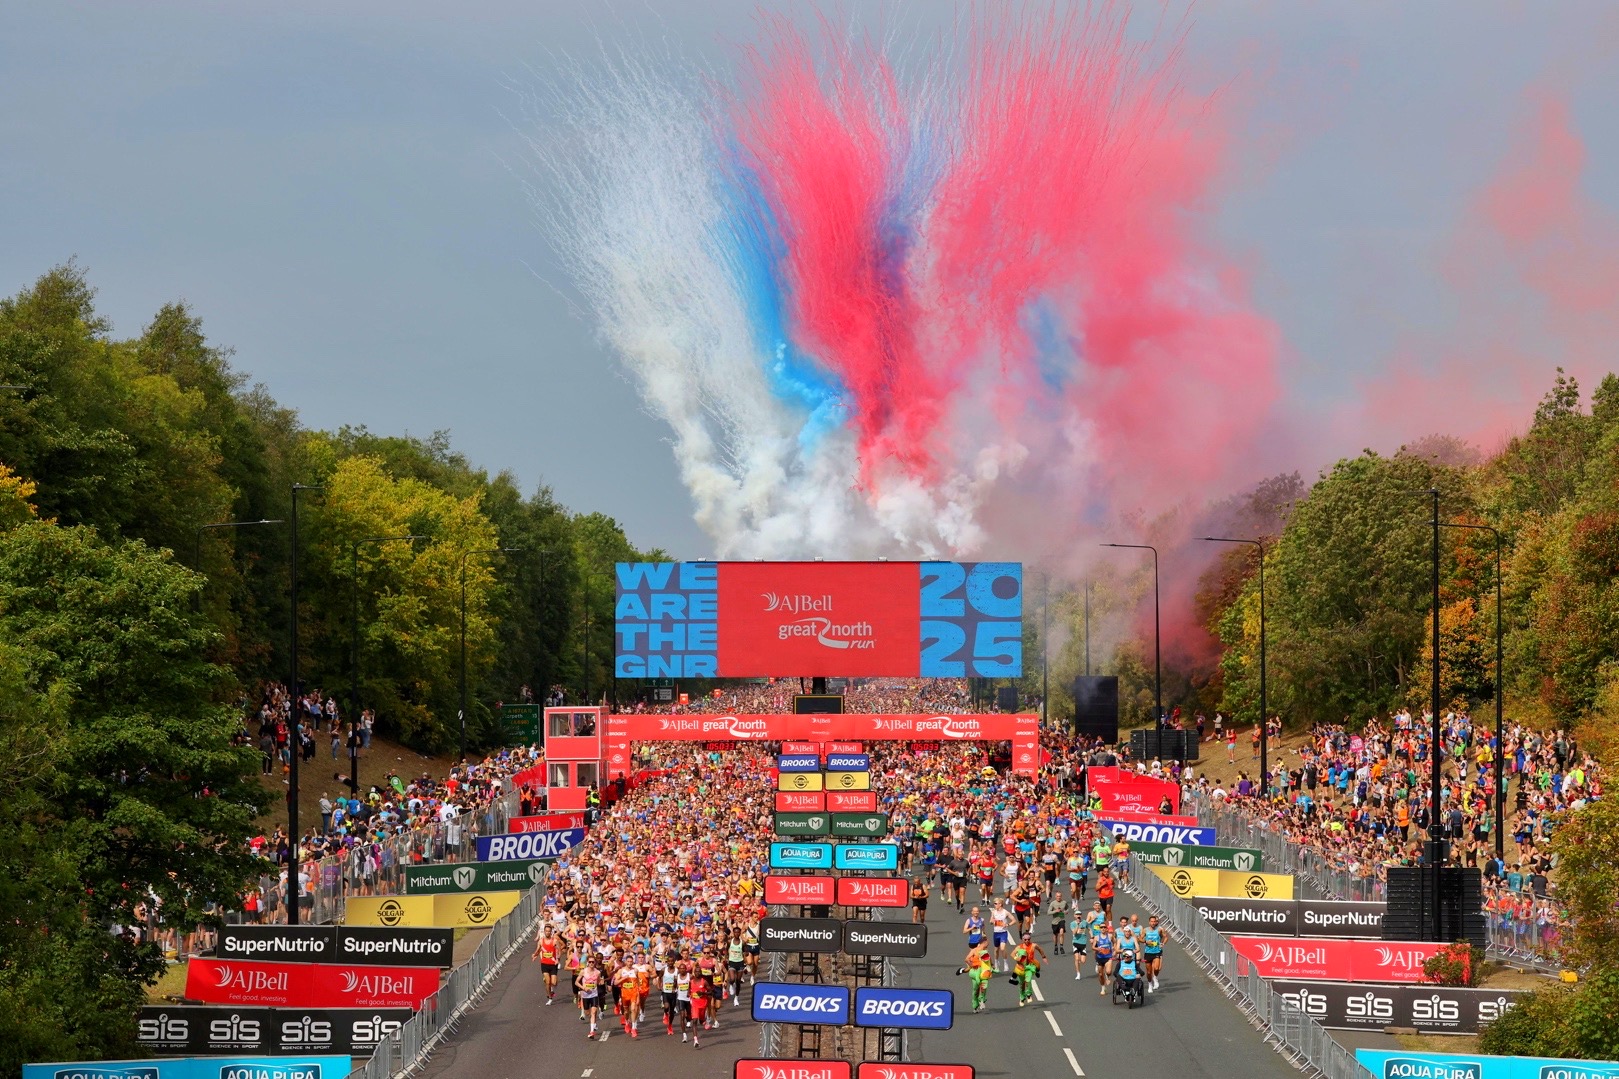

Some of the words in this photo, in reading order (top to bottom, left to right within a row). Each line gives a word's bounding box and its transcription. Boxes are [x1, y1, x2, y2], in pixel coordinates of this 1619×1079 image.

[615, 562, 717, 589] WE
[920, 562, 1022, 617] 20
[615, 593, 717, 619] ARE
[615, 623, 717, 650] THE
[779, 622, 817, 640] great
[832, 621, 872, 636] north
[850, 640, 875, 649] run
[920, 620, 1022, 677] 25
[615, 654, 717, 678] GNR
[703, 720, 728, 731] great
[739, 719, 766, 730] north
[916, 720, 942, 731] great
[952, 719, 979, 729] north
[779, 820, 807, 828] Mitchum
[836, 821, 863, 829] Mitchum
[488, 831, 572, 861] BROOKS
[782, 849, 801, 857] AQUA
[801, 850, 820, 858] PURA
[847, 850, 866, 858] AQUA
[1194, 856, 1231, 868] Mitchum
[410, 875, 451, 888] Mitchum
[487, 871, 526, 883] Mitchum
[1170, 878, 1194, 886] SOLGAR
[1244, 884, 1268, 892] SOLGAR
[465, 906, 492, 914] SOLGAR
[760, 994, 842, 1013] BROOKS
[862, 999, 945, 1017] BROOKS
[227, 1069, 270, 1079] AQUA
[1389, 1063, 1432, 1078] AQUA
[1434, 1067, 1474, 1079] PURA
